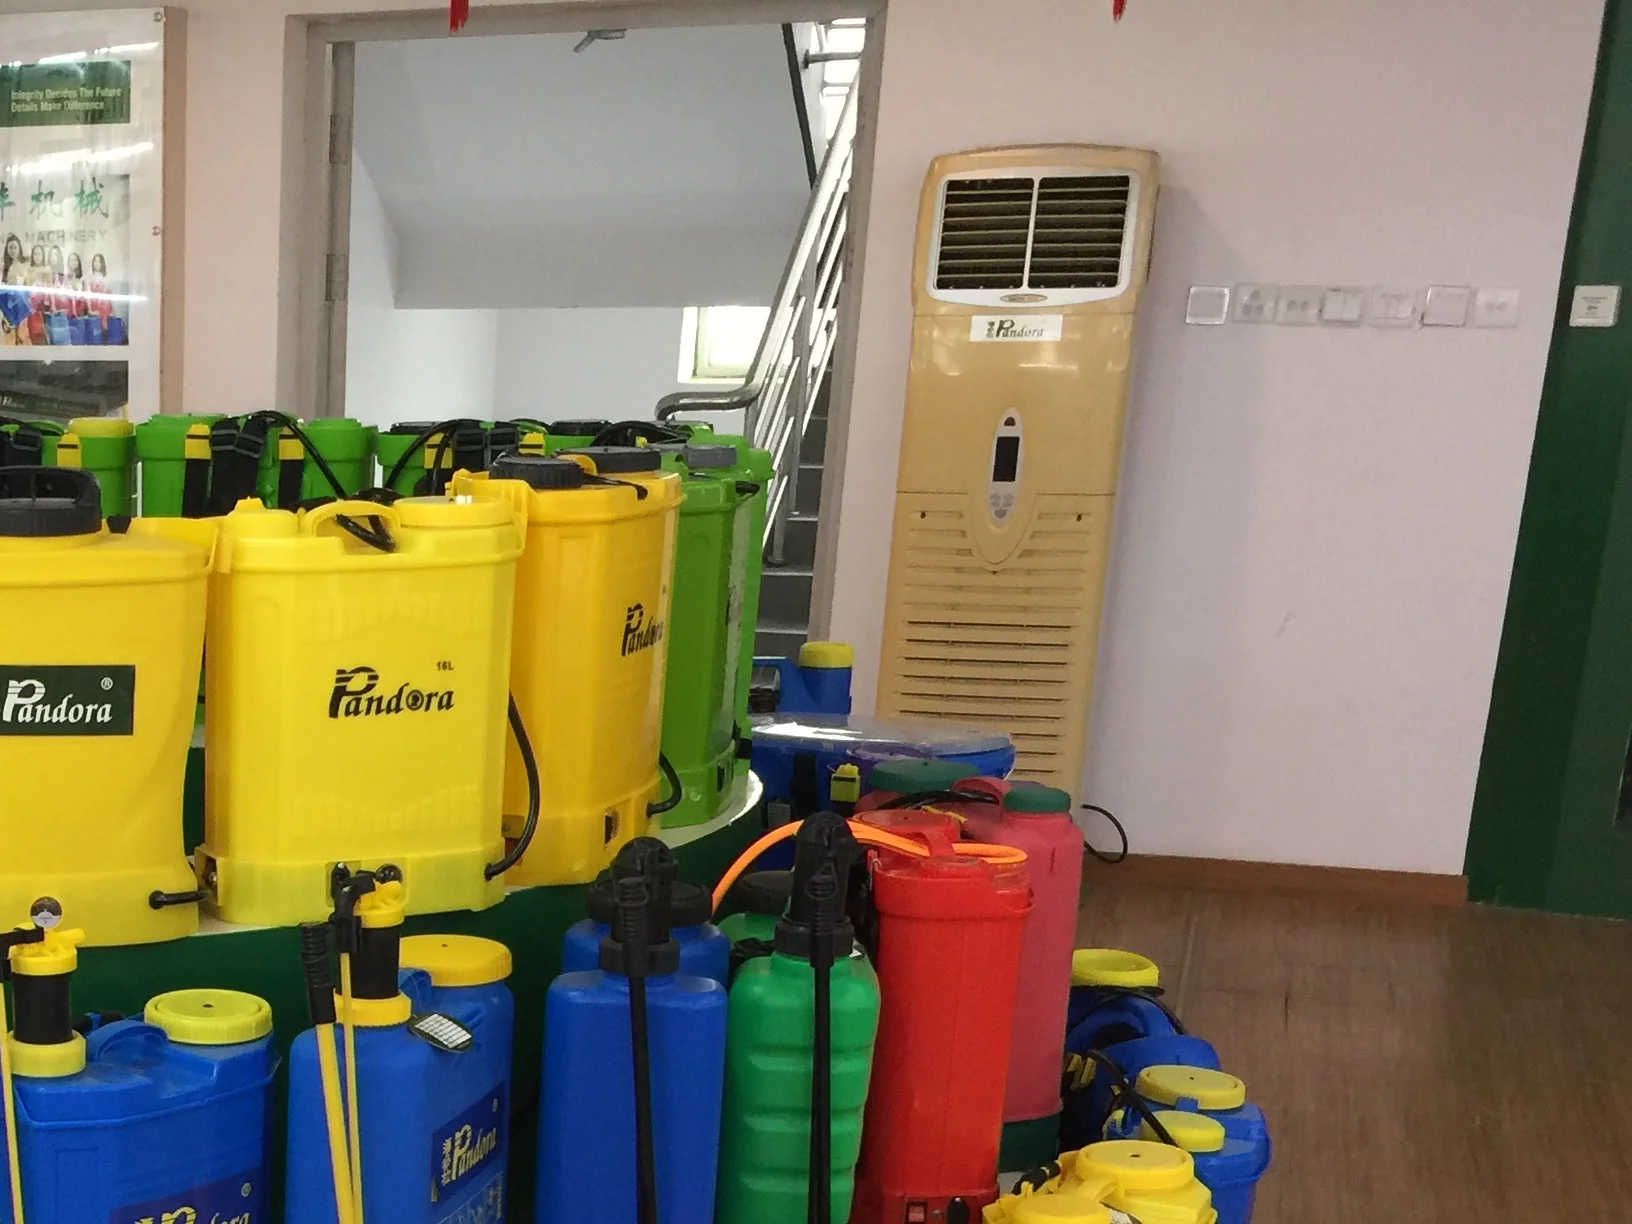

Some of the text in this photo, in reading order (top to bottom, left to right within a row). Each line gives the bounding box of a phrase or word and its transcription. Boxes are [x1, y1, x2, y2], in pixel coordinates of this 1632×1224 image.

[79, 87, 94, 97] The
[25, 229, 107, 245] MACHINERY
[996, 319, 1045, 338] Pandora
[437, 661, 454, 671] 16L
[2, 679, 112, 723] Pandora
[329, 666, 455, 719] Pandora
[452, 1123, 497, 1181] Pandora
